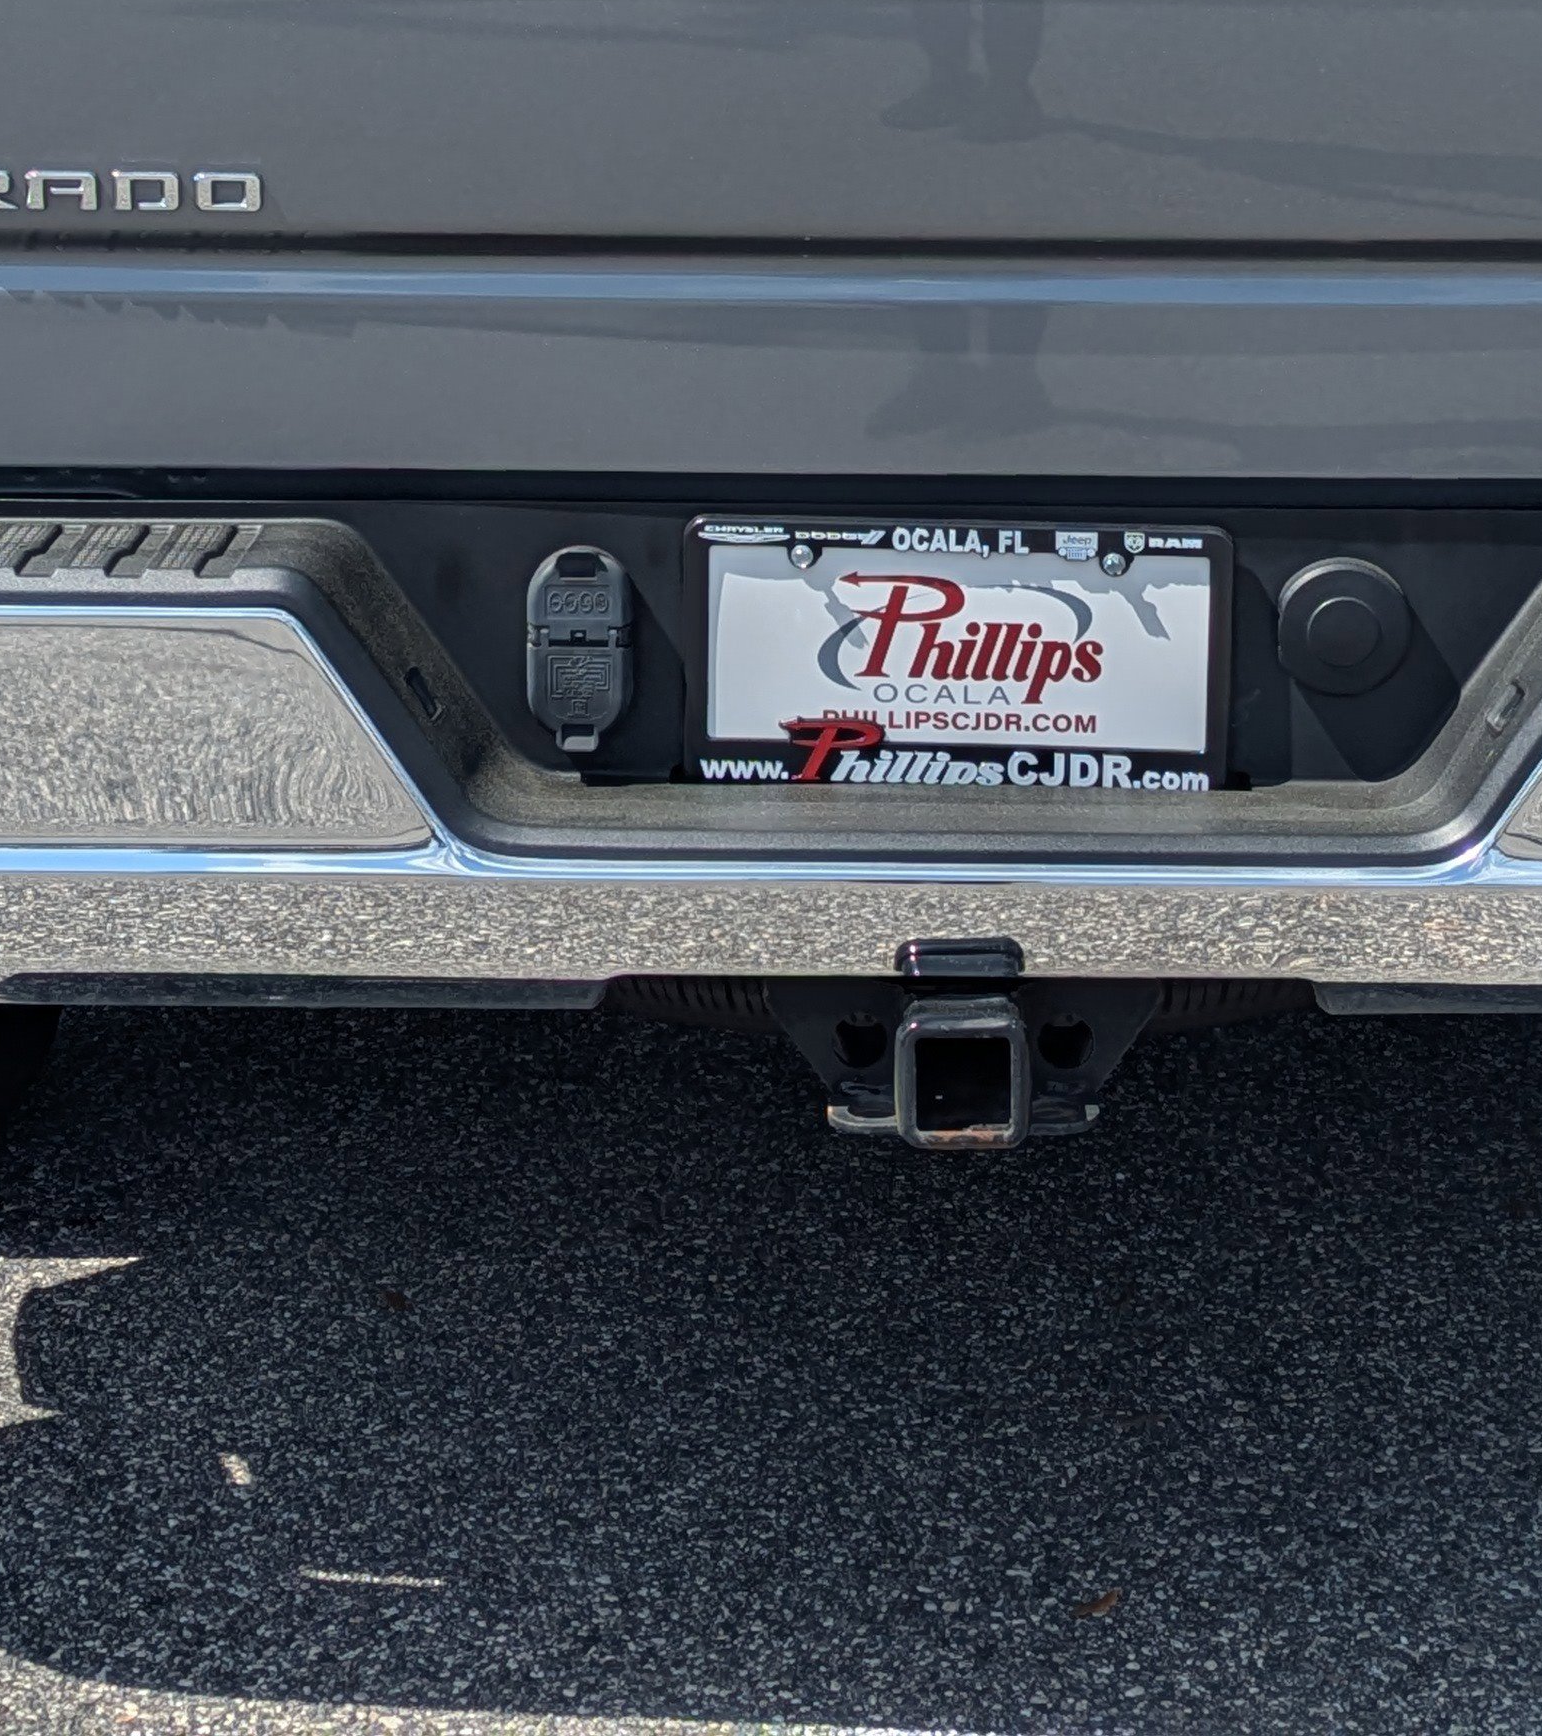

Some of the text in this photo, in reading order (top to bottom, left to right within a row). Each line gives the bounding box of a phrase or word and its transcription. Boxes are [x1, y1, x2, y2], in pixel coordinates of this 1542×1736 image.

[892, 526, 990, 558] OCALA,
[999, 530, 1030, 555] FL
[1148, 537, 1203, 550] RAM
[838, 571, 1104, 705] Phillips
[873, 683, 1011, 705] OCALA
